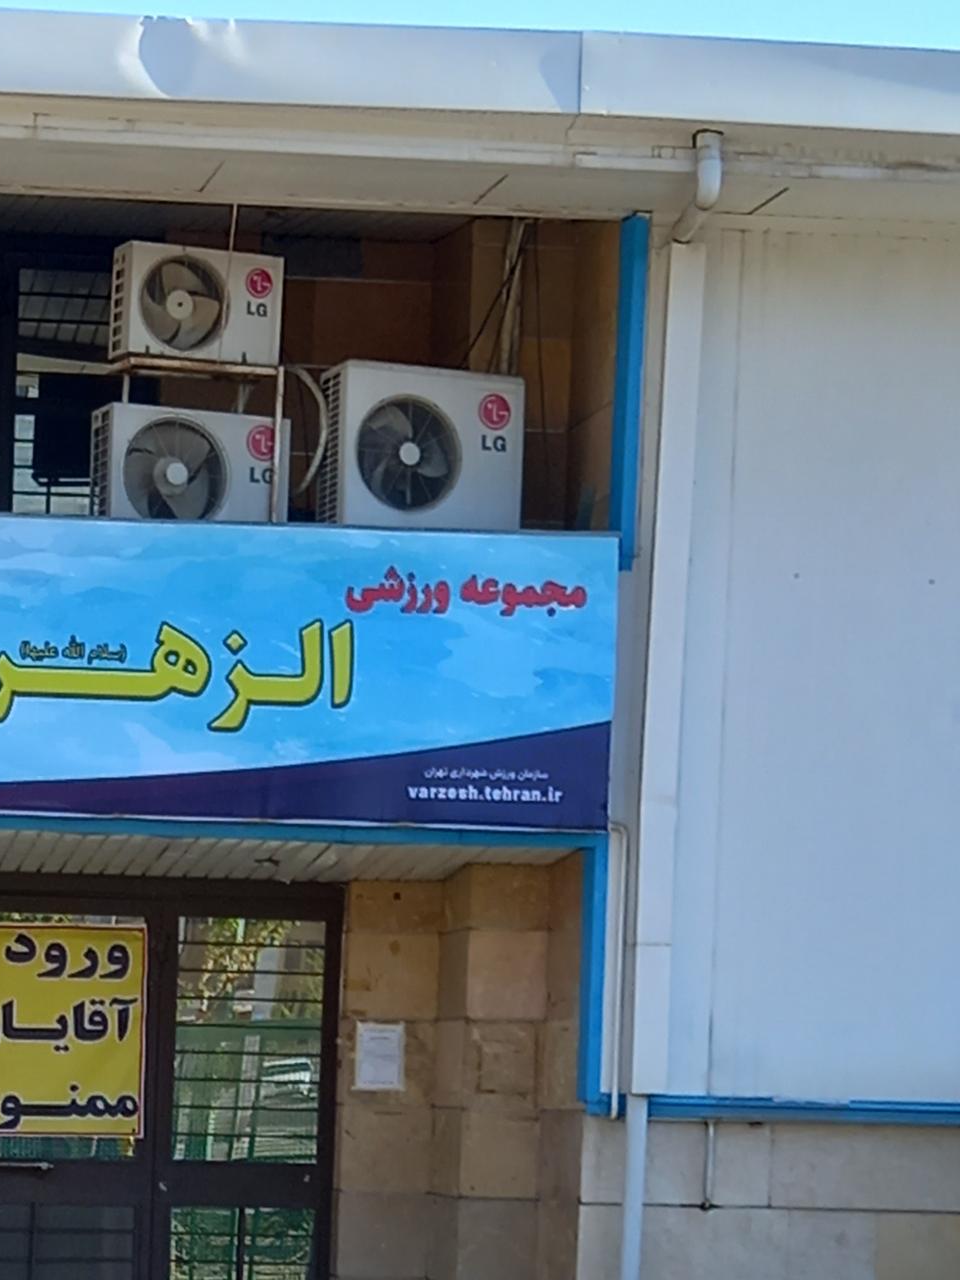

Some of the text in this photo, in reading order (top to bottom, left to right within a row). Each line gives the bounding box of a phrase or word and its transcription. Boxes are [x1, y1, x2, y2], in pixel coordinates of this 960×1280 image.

[247, 300, 268, 318] LG
[481, 434, 507, 453] LG
[345, 565, 588, 617] مجموعه ورزشی
[407, 784, 563, 803] varzesh.tehran.ir
[4, 932, 131, 980] ورود
